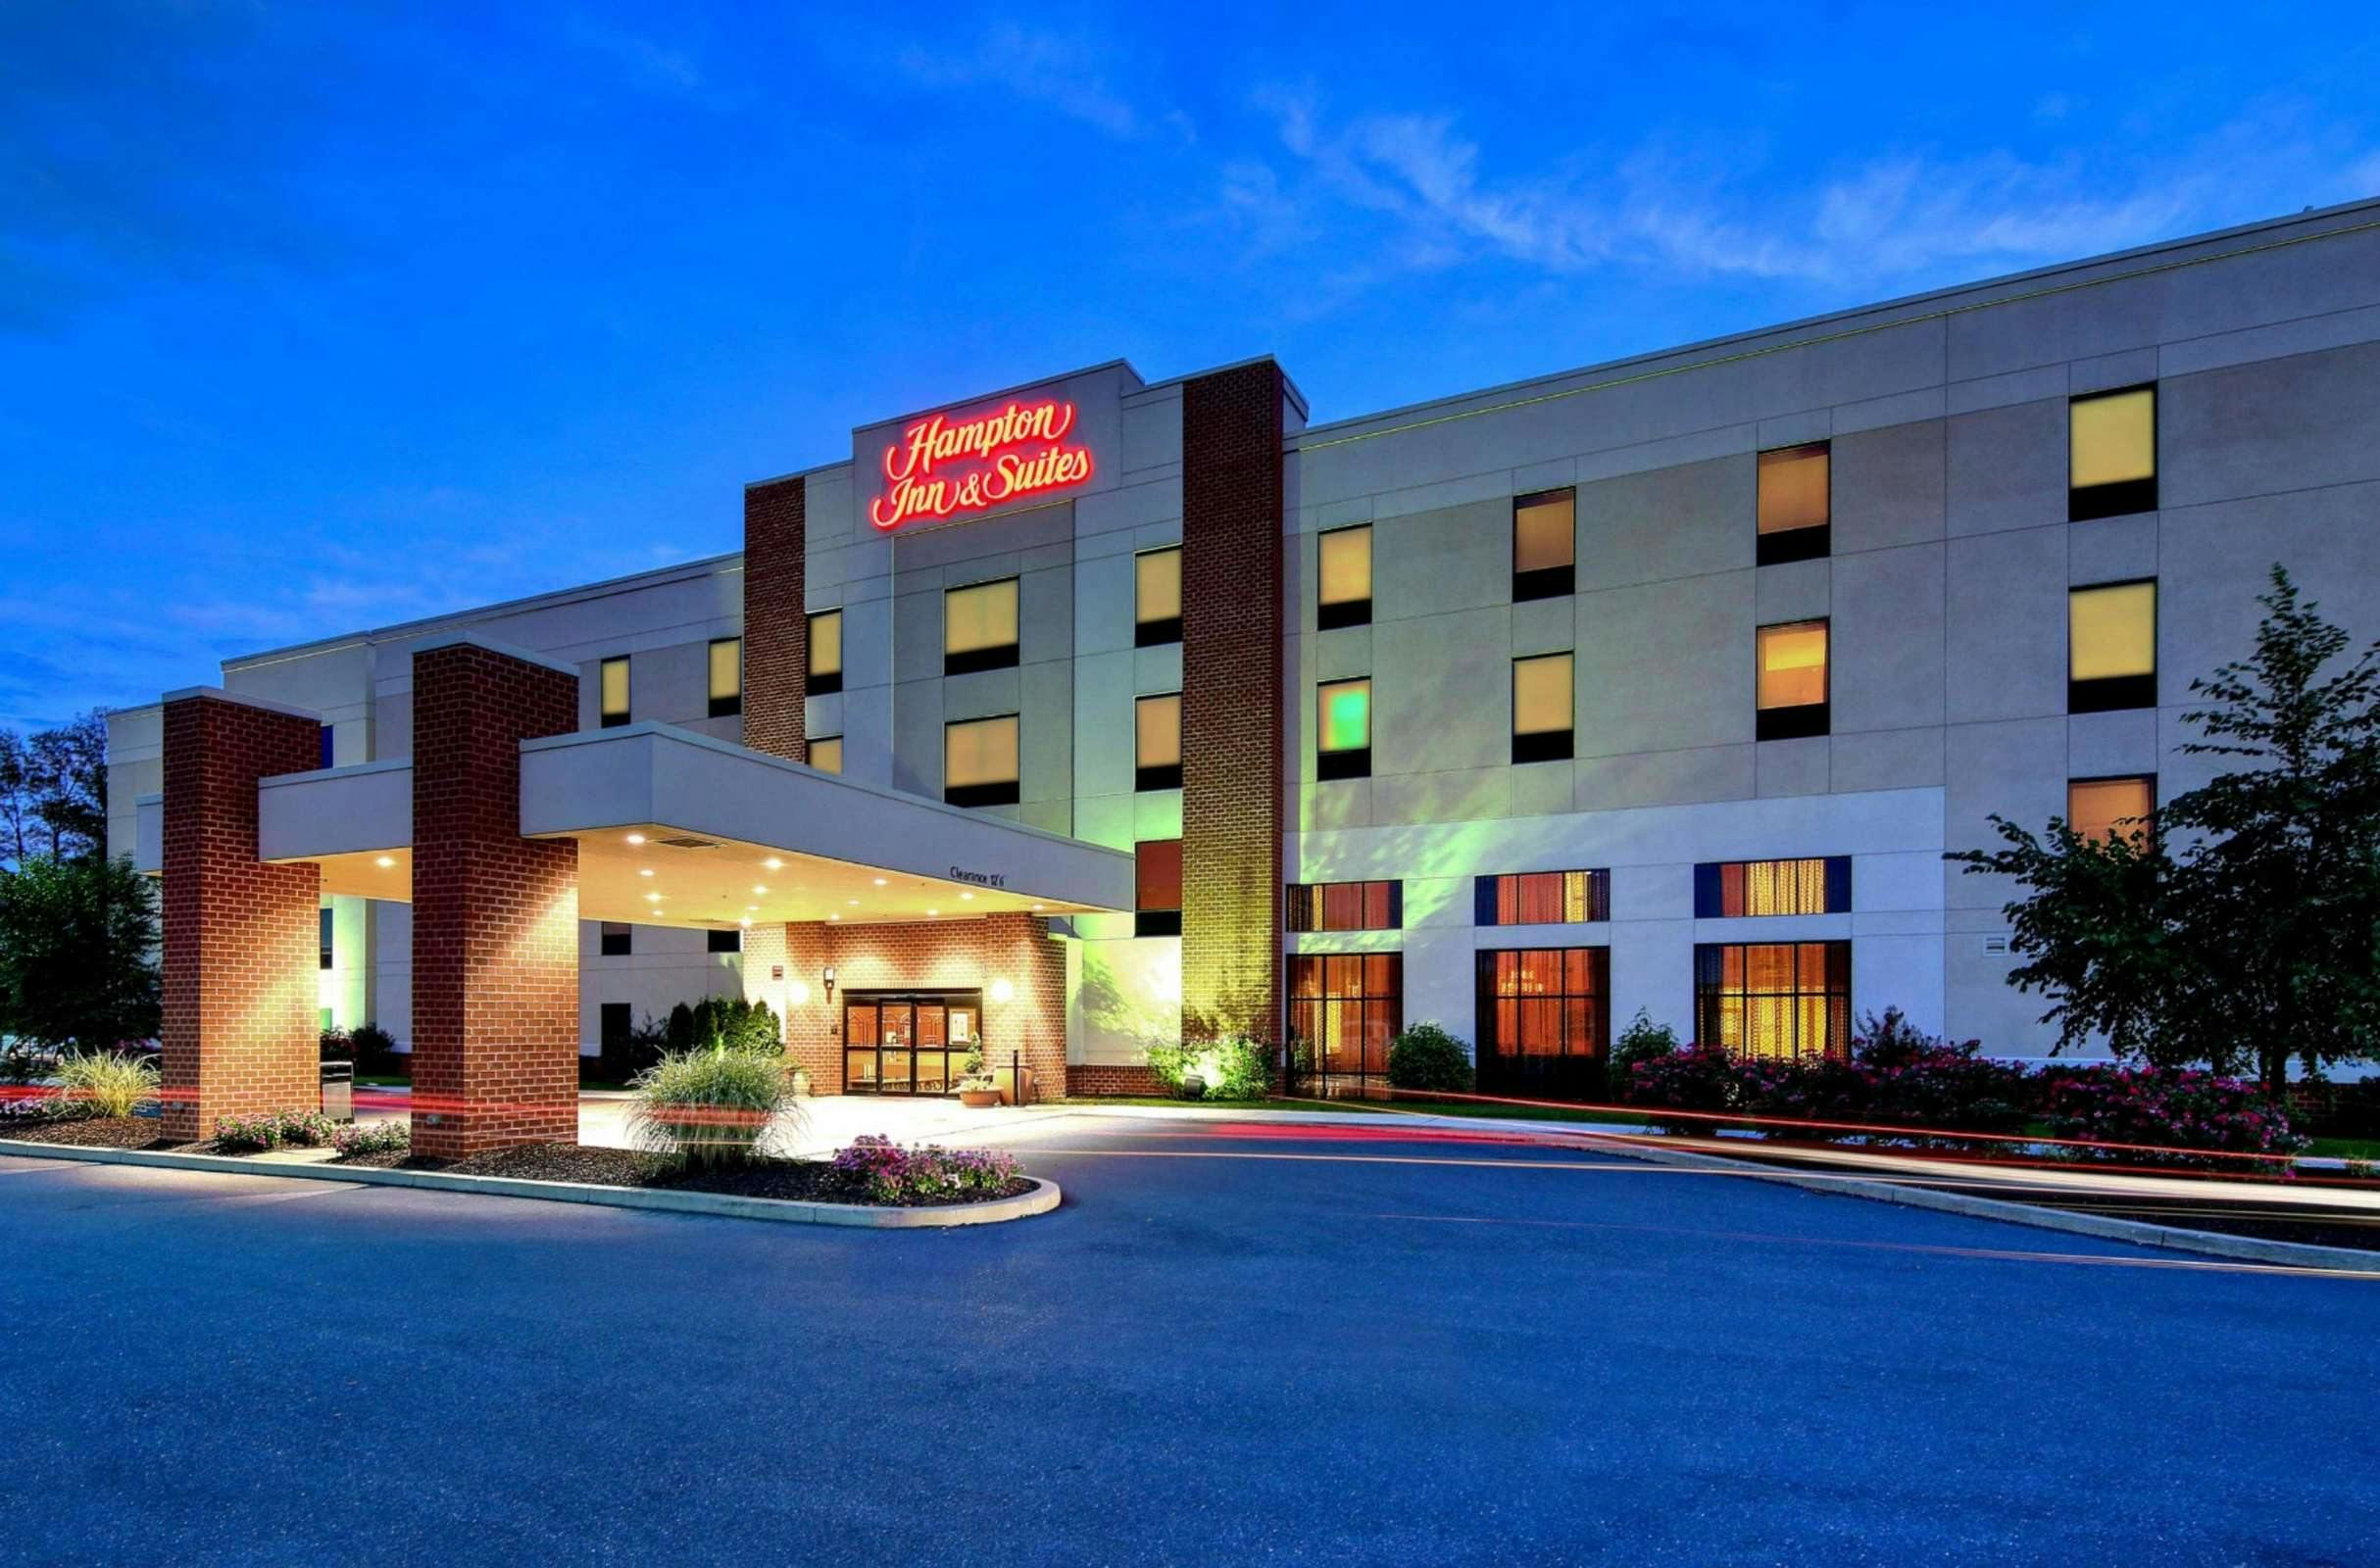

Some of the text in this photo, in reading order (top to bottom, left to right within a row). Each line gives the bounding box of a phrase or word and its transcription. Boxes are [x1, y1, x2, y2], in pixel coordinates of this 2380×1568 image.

[886, 404, 1071, 481] Hampton
[872, 447, 1089, 527] Inn & Suites
